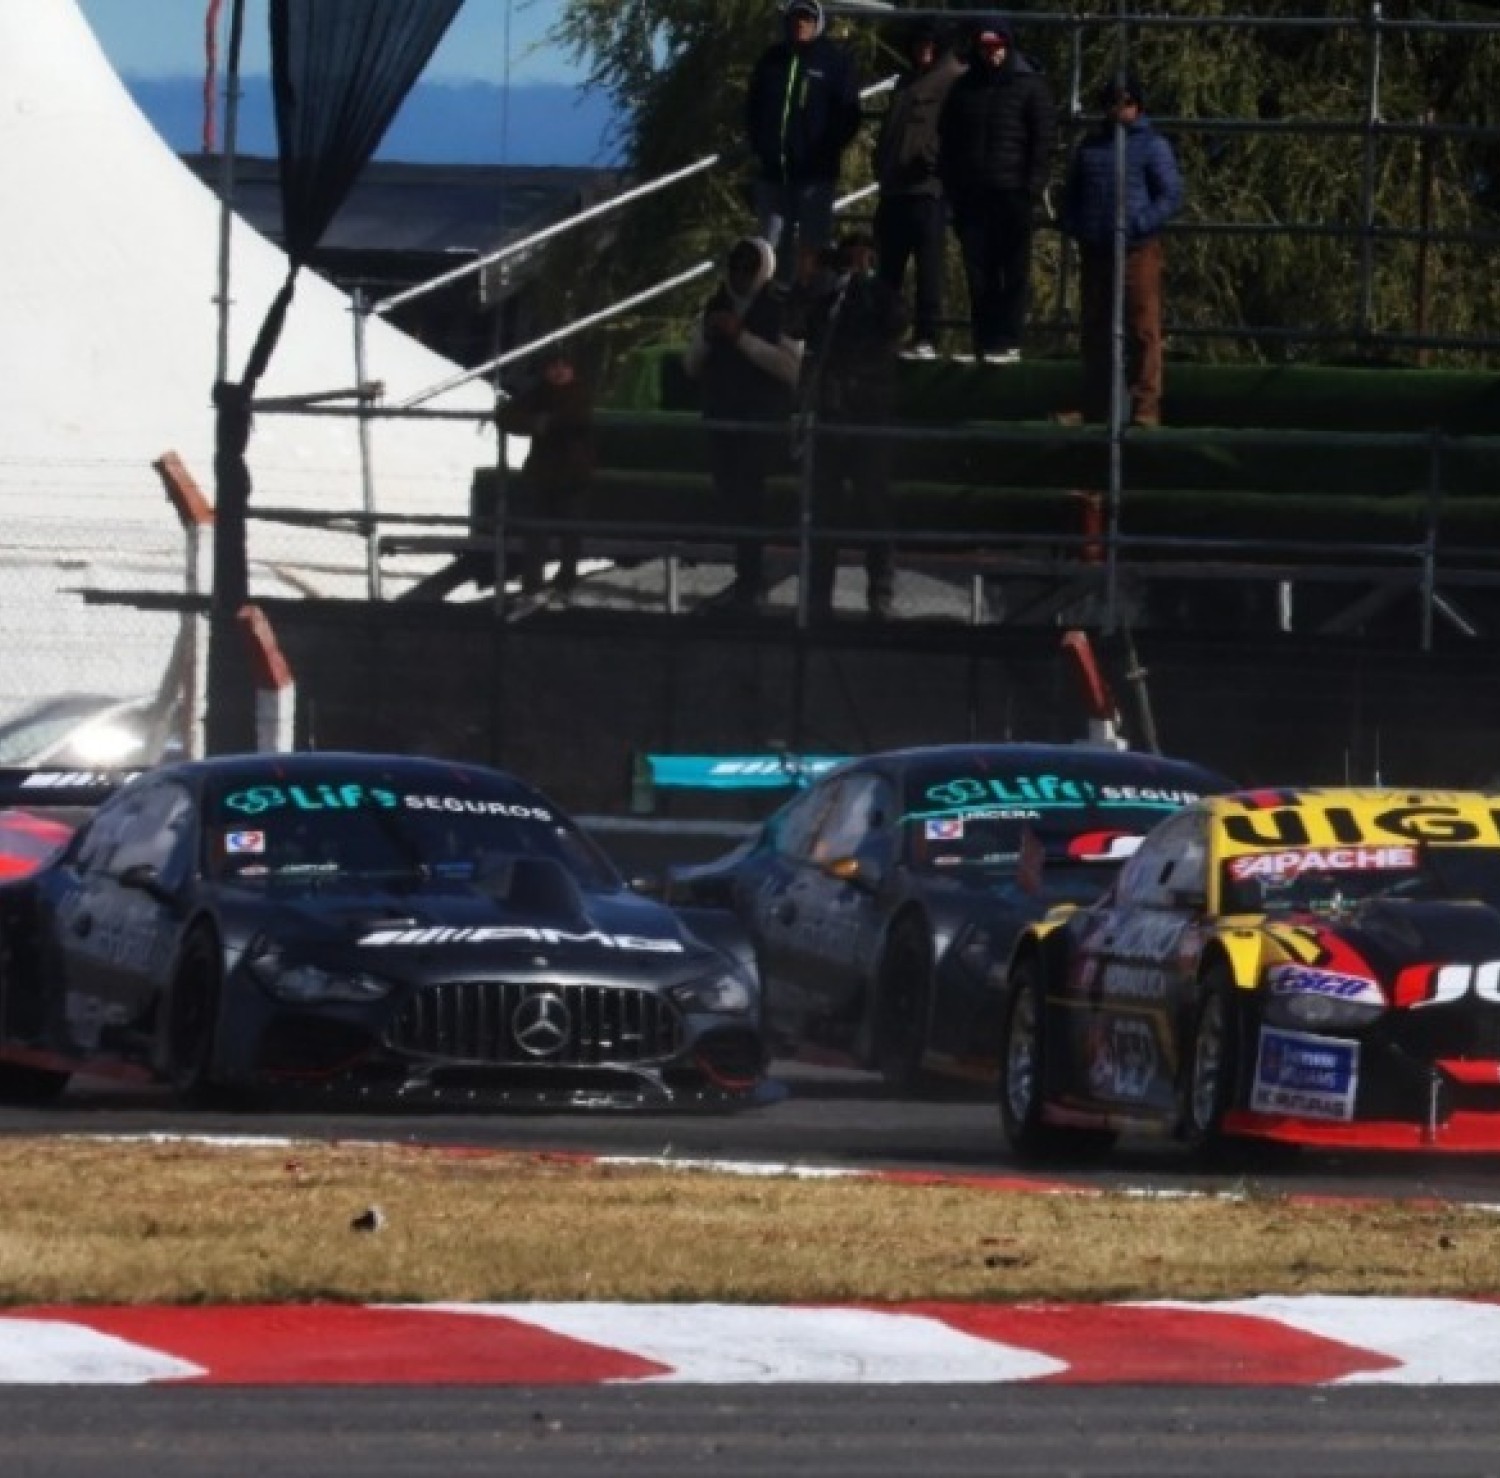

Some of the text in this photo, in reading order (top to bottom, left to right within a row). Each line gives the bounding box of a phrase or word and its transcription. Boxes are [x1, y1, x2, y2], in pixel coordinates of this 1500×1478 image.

[403, 794, 553, 822] SEGUROS
[1245, 847, 1418, 879] APACHE
[464, 926, 684, 952] AMG
